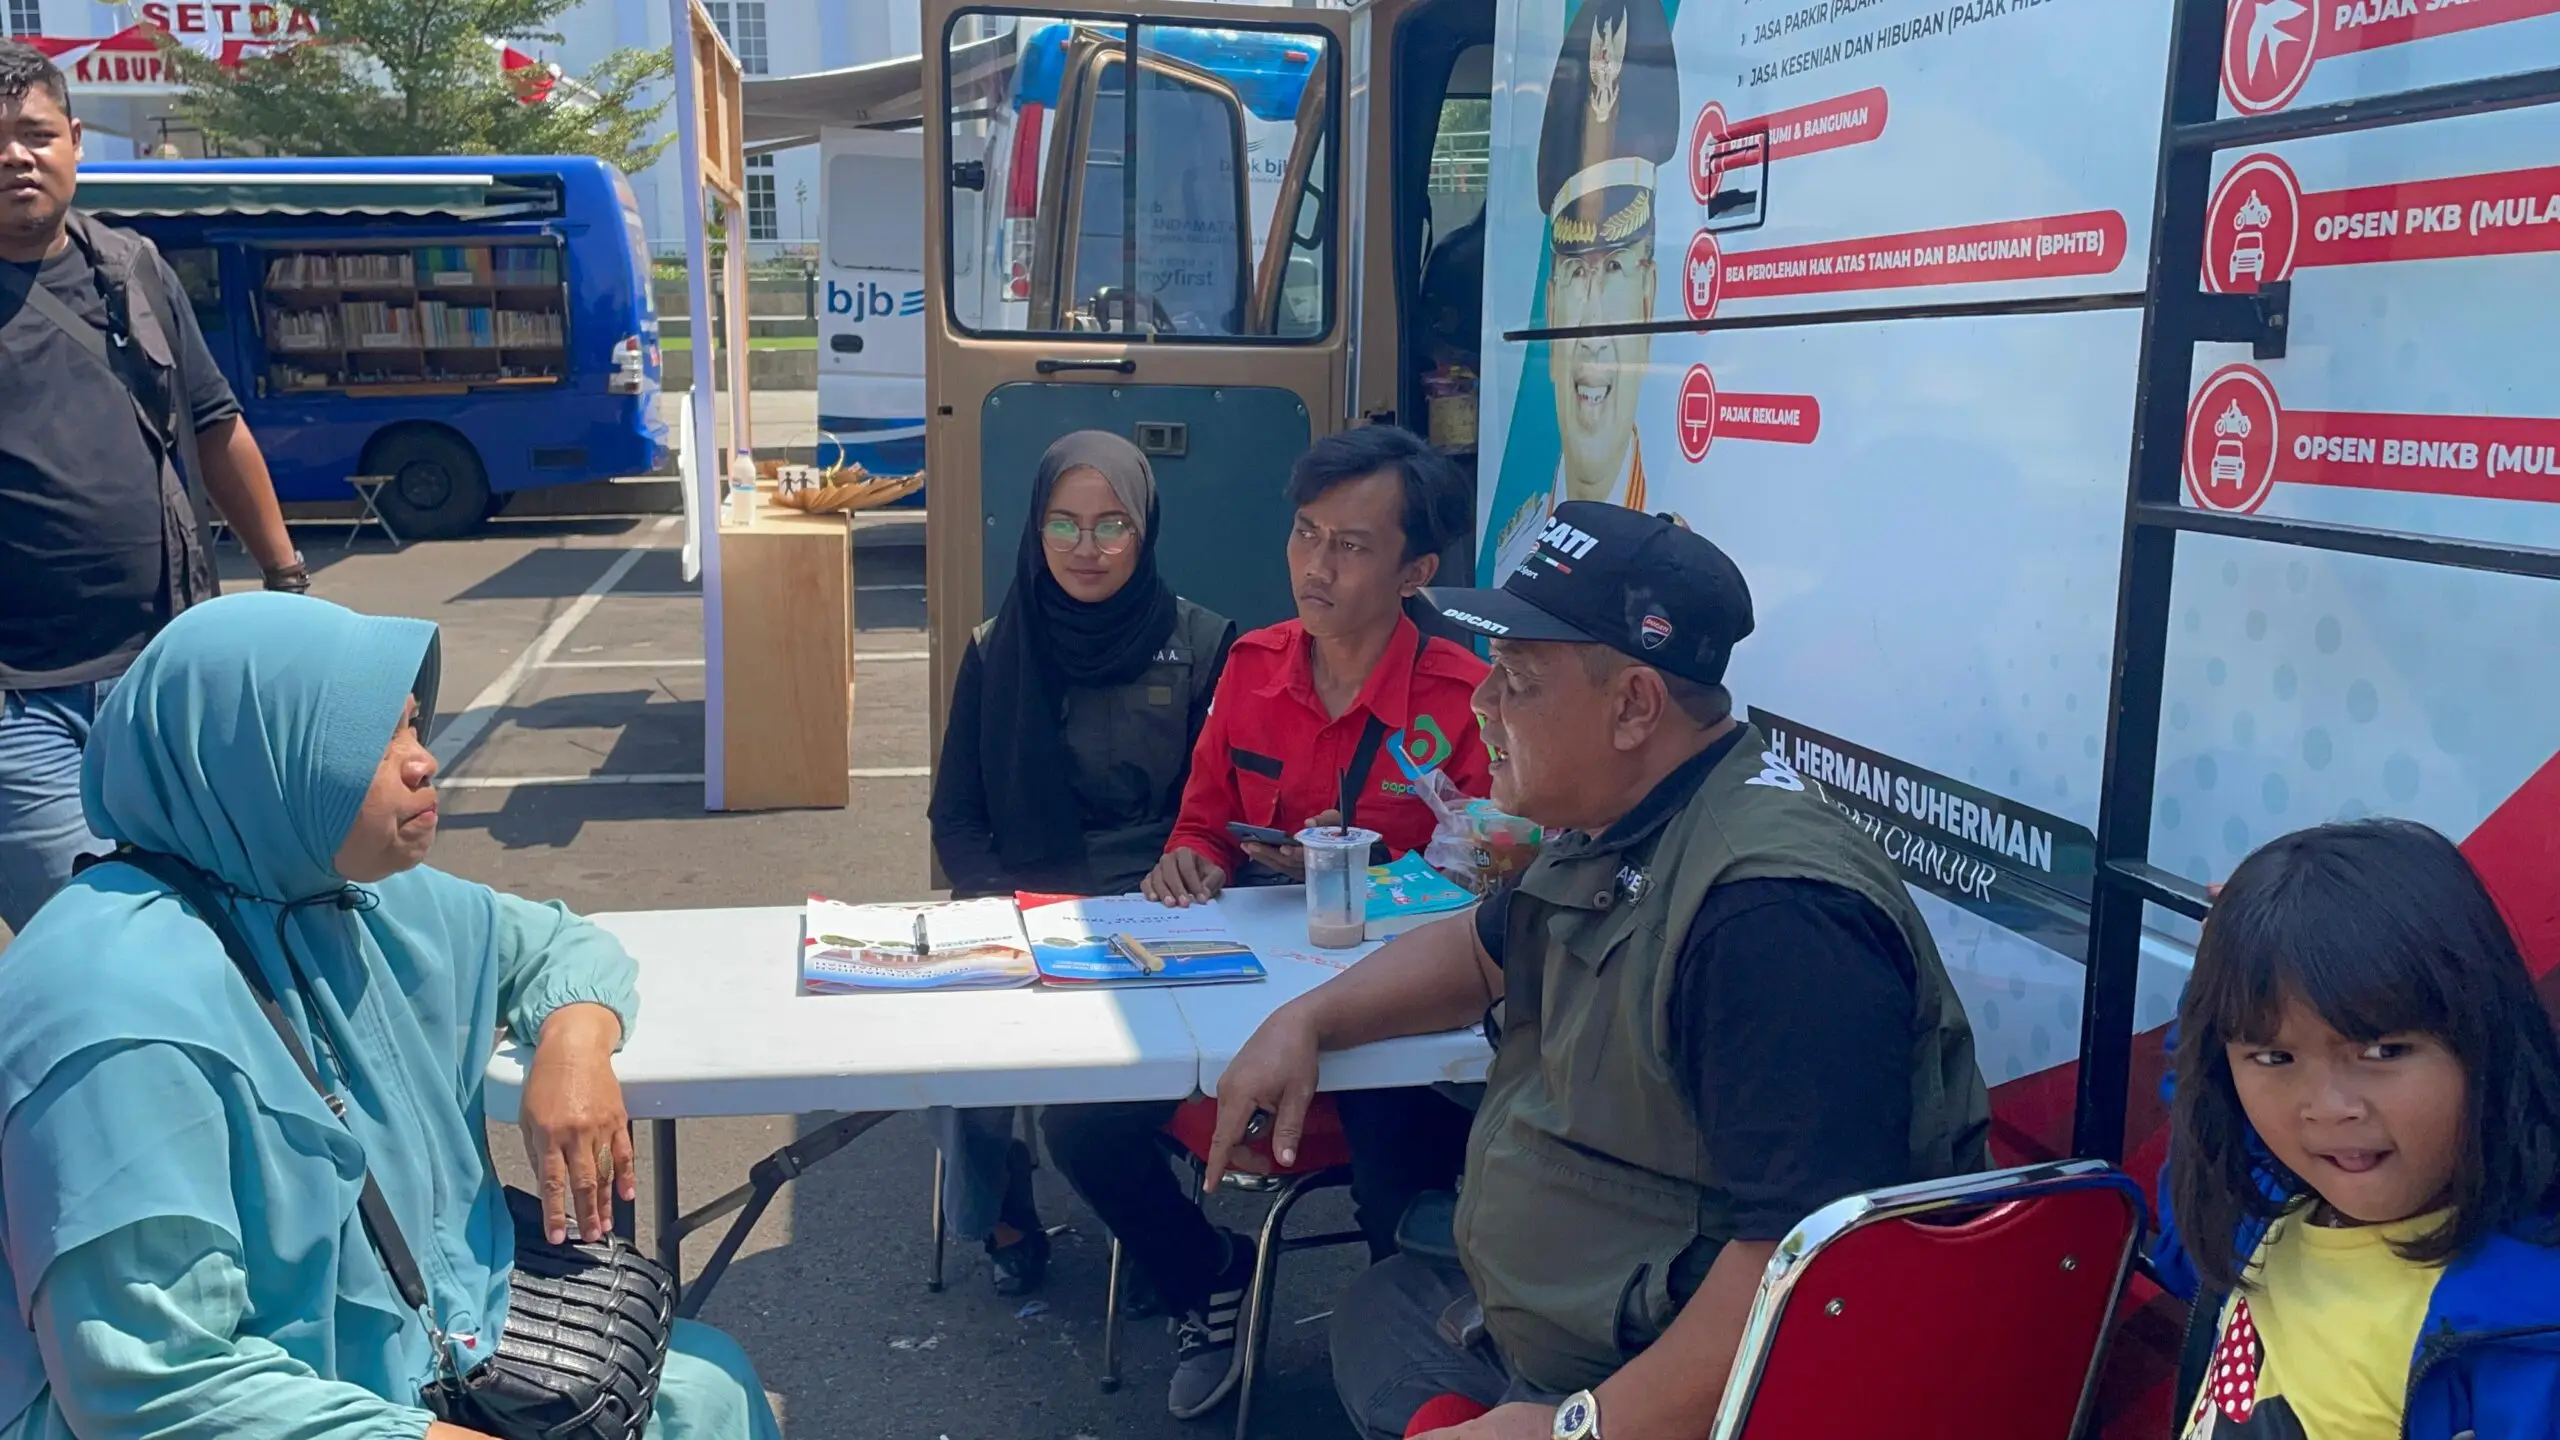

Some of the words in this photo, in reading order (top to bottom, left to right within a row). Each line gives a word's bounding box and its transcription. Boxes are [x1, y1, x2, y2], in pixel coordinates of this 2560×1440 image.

[142, 3, 318, 34] SETDA
[1753, 18, 1781, 44] JASA
[1785, 3, 1828, 34] PARKIR
[2334, 0, 2418, 31] PAJAK
[1749, 63, 1778, 87] JASA
[1781, 42, 1841, 78] KESENIAN
[1844, 32, 1873, 60] DAN
[1876, 11, 1944, 51] HIBURAN
[1949, 0, 2006, 35] (PAJAK
[1793, 122, 1802, 139] &
[1804, 106, 1868, 138] BANGUNAN
[2314, 209, 2398, 242] OPSEN
[2405, 204, 2462, 234] PKB
[1726, 265, 1745, 282] BEA
[1747, 262, 1807, 281] PEROLEHAN
[1809, 258, 1833, 276] HAK
[1835, 255, 1865, 273] ATAS
[1868, 249, 1911, 270] TANAH
[1914, 245, 1943, 267] DAN
[1947, 238, 2032, 265] BANGUNAN
[2036, 229, 2104, 260] (BPHTB)
[828, 280, 894, 322] bjb
[1720, 406, 1751, 423] PAJAK
[1752, 407, 1800, 426] REKLAME
[2293, 434, 2376, 463] OPSEN
[2382, 439, 2479, 470] BBNKB
[2486, 442, 2560, 478] (MUL
[1442, 608, 1510, 635] DUCATI
[1795, 737, 1891, 808] HERMAN
[1895, 776, 2053, 873] SUHERMAN
[1884, 826, 1996, 903] CIANJUR
